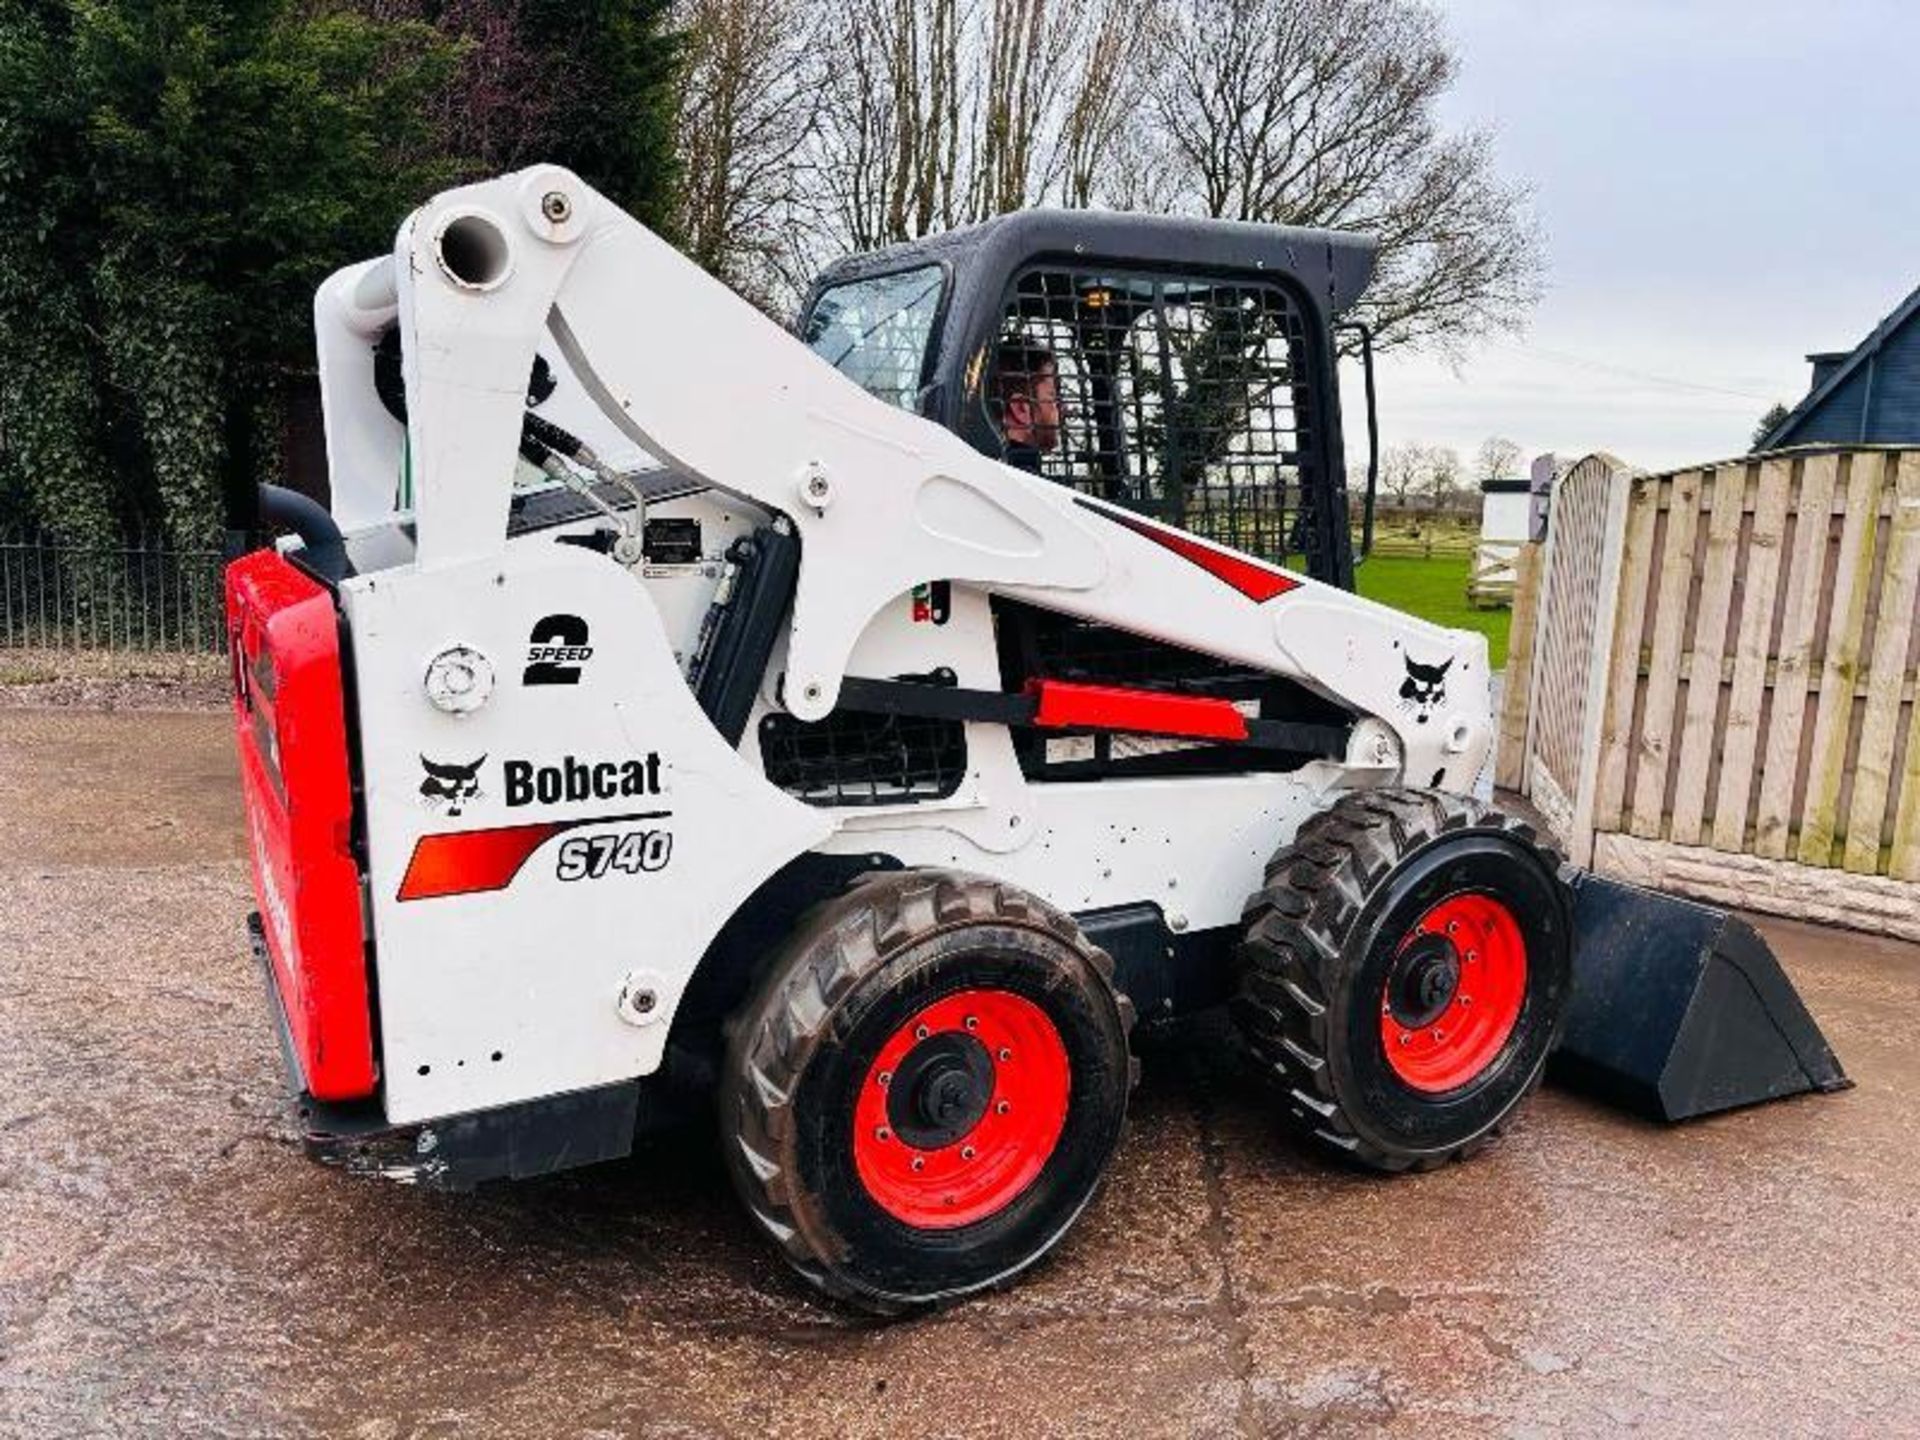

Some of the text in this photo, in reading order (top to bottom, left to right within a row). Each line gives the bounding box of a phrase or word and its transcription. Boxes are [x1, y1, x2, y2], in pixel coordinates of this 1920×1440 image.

[522, 613, 589, 686] 2
[527, 647, 594, 661] SPEED
[503, 752, 661, 806] Bobcat
[556, 831, 672, 881] S740
